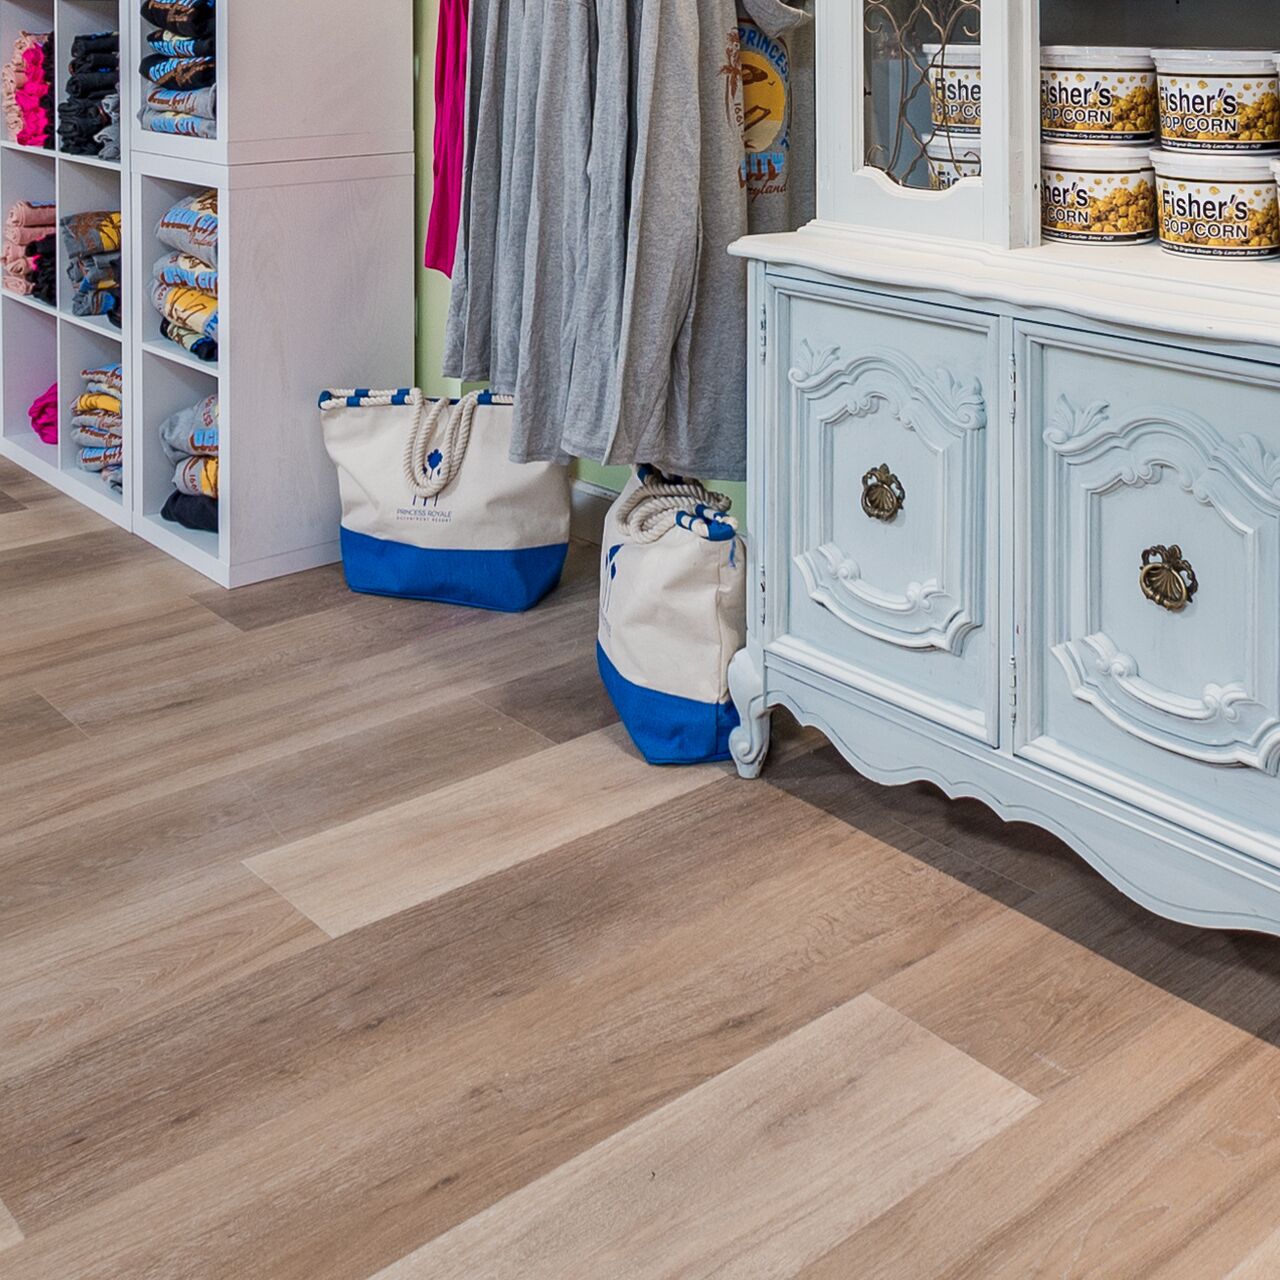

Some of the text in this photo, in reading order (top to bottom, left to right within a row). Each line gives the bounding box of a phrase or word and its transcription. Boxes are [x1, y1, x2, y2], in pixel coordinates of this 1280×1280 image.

[1041, 79, 1112, 106] Fisher's
[1159, 87, 1237, 115] Fisher's
[1063, 108, 1112, 123] CORN
[1184, 116, 1238, 133] CORN
[1162, 189, 1249, 221] Fisher's
[1047, 206, 1089, 224] CORN
[1163, 217, 1249, 238] POP CORN
[396, 508, 452, 518] PRINCESS ROYALE
